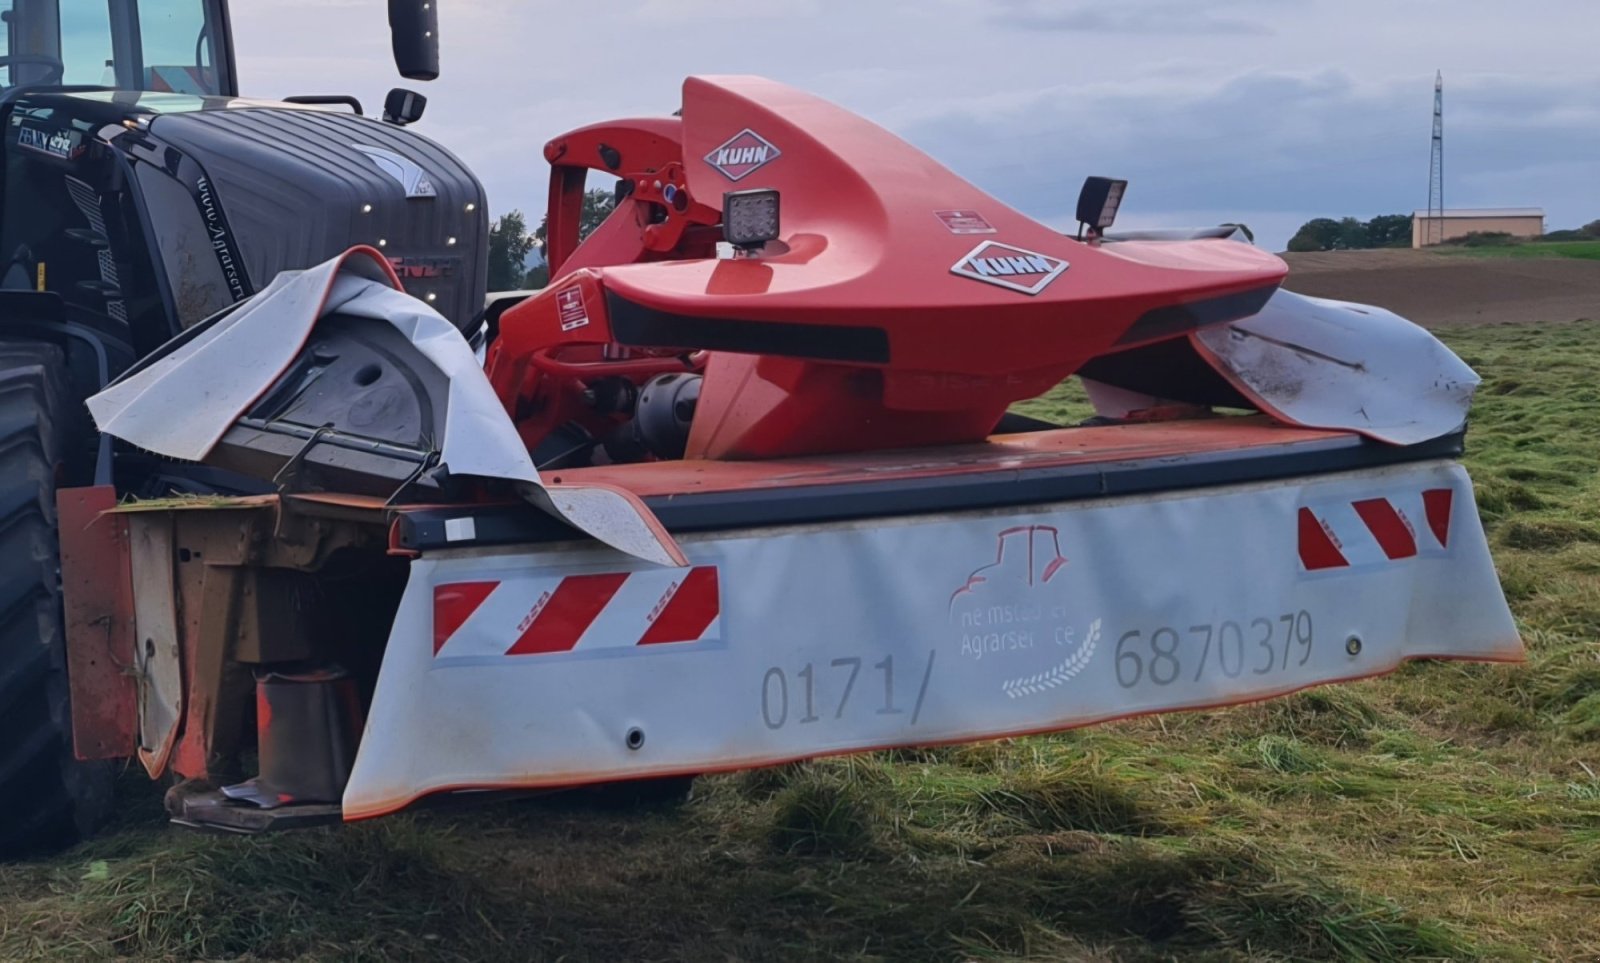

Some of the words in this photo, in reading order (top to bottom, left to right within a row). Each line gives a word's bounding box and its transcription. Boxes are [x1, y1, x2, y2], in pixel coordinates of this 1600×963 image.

[716, 145, 769, 166] KUHN
[967, 255, 1054, 277] KUHN
[961, 625, 1075, 660] Agrarserce
[761, 649, 936, 730] 0171/
[1114, 609, 1313, 689] 6870379
